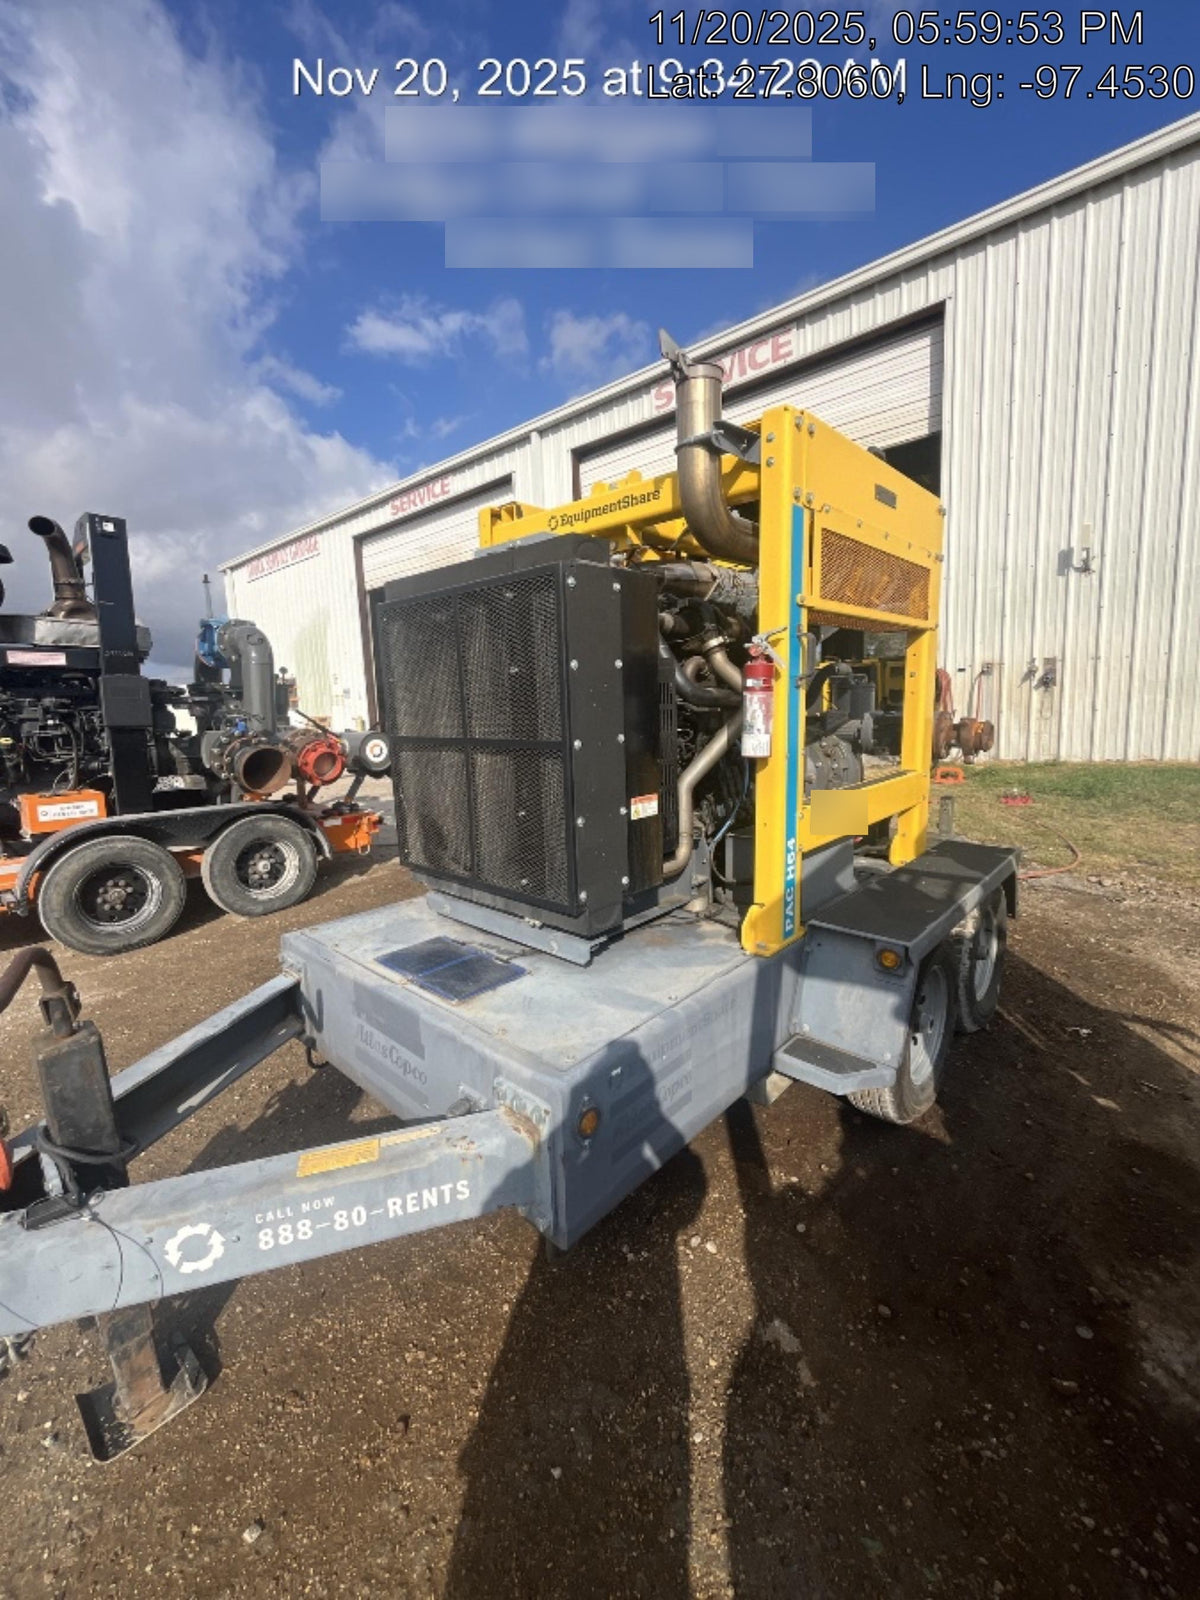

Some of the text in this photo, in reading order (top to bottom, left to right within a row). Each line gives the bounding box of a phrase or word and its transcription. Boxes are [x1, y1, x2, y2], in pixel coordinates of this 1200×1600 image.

[654, 334, 793, 411] SVICE
[390, 478, 449, 516] SERVICE
[559, 489, 661, 526] EquipmentShare
[785, 887, 795, 932] PAC
[255, 1196, 335, 1224] CALL NOW
[258, 1180, 470, 1250] 888-80-RENTS
